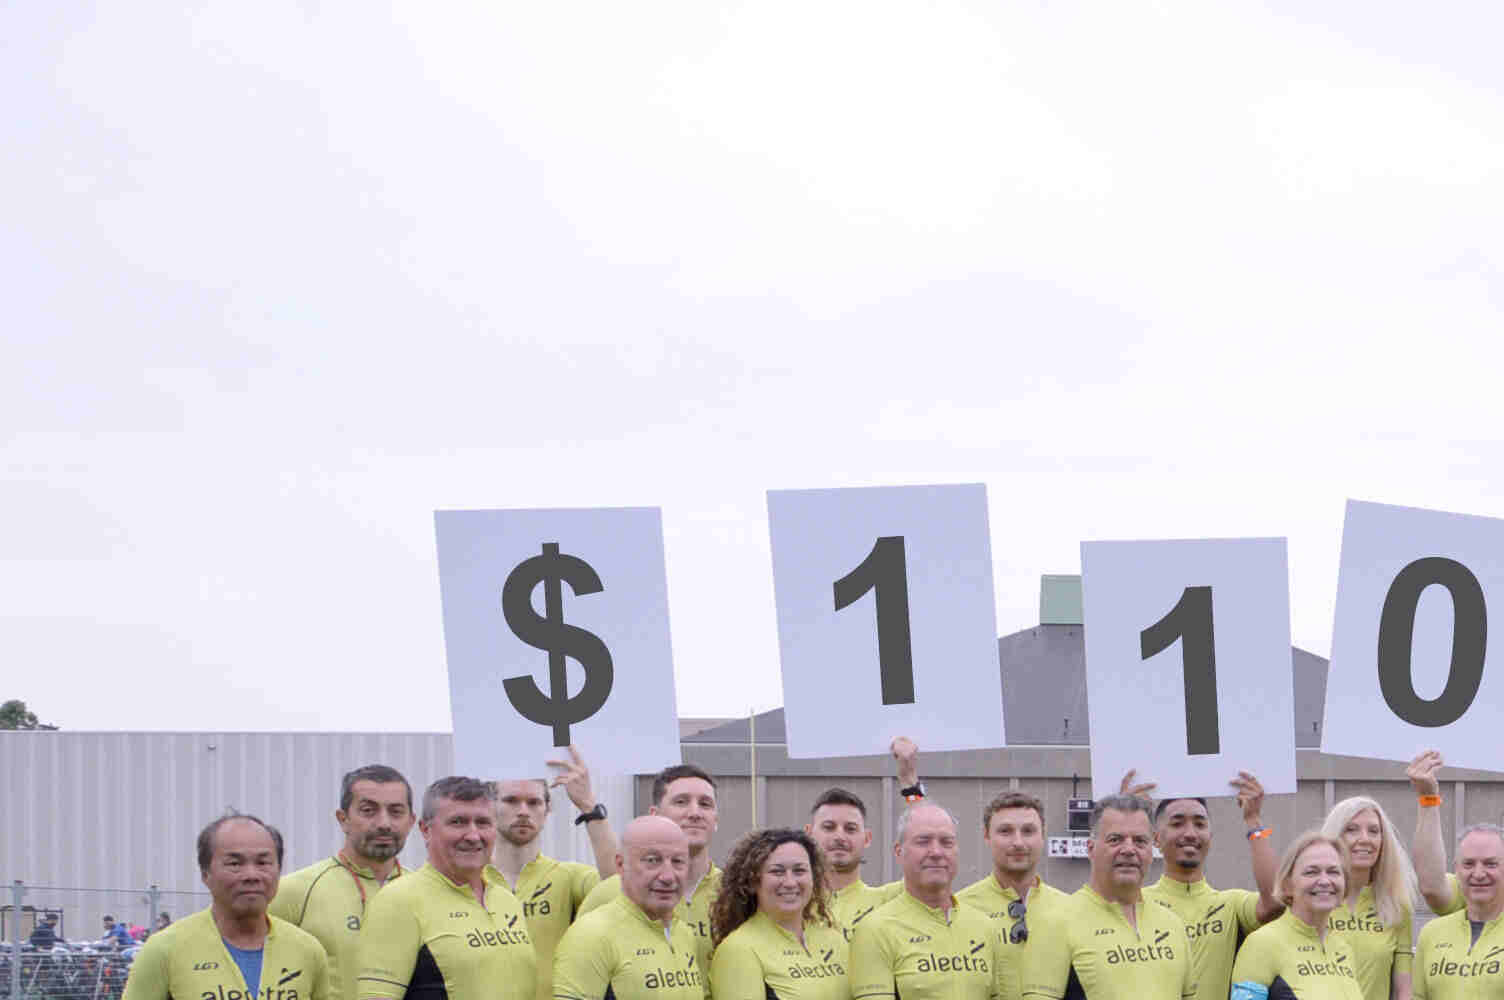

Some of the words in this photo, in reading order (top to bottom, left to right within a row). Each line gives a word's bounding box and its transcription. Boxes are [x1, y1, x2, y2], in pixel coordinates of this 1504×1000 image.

[917, 953, 989, 974] alectra
[1106, 944, 1175, 965] alectra
[788, 962, 845, 979] alectra
[1297, 959, 1354, 979] alectra
[1429, 959, 1500, 978] alectra
